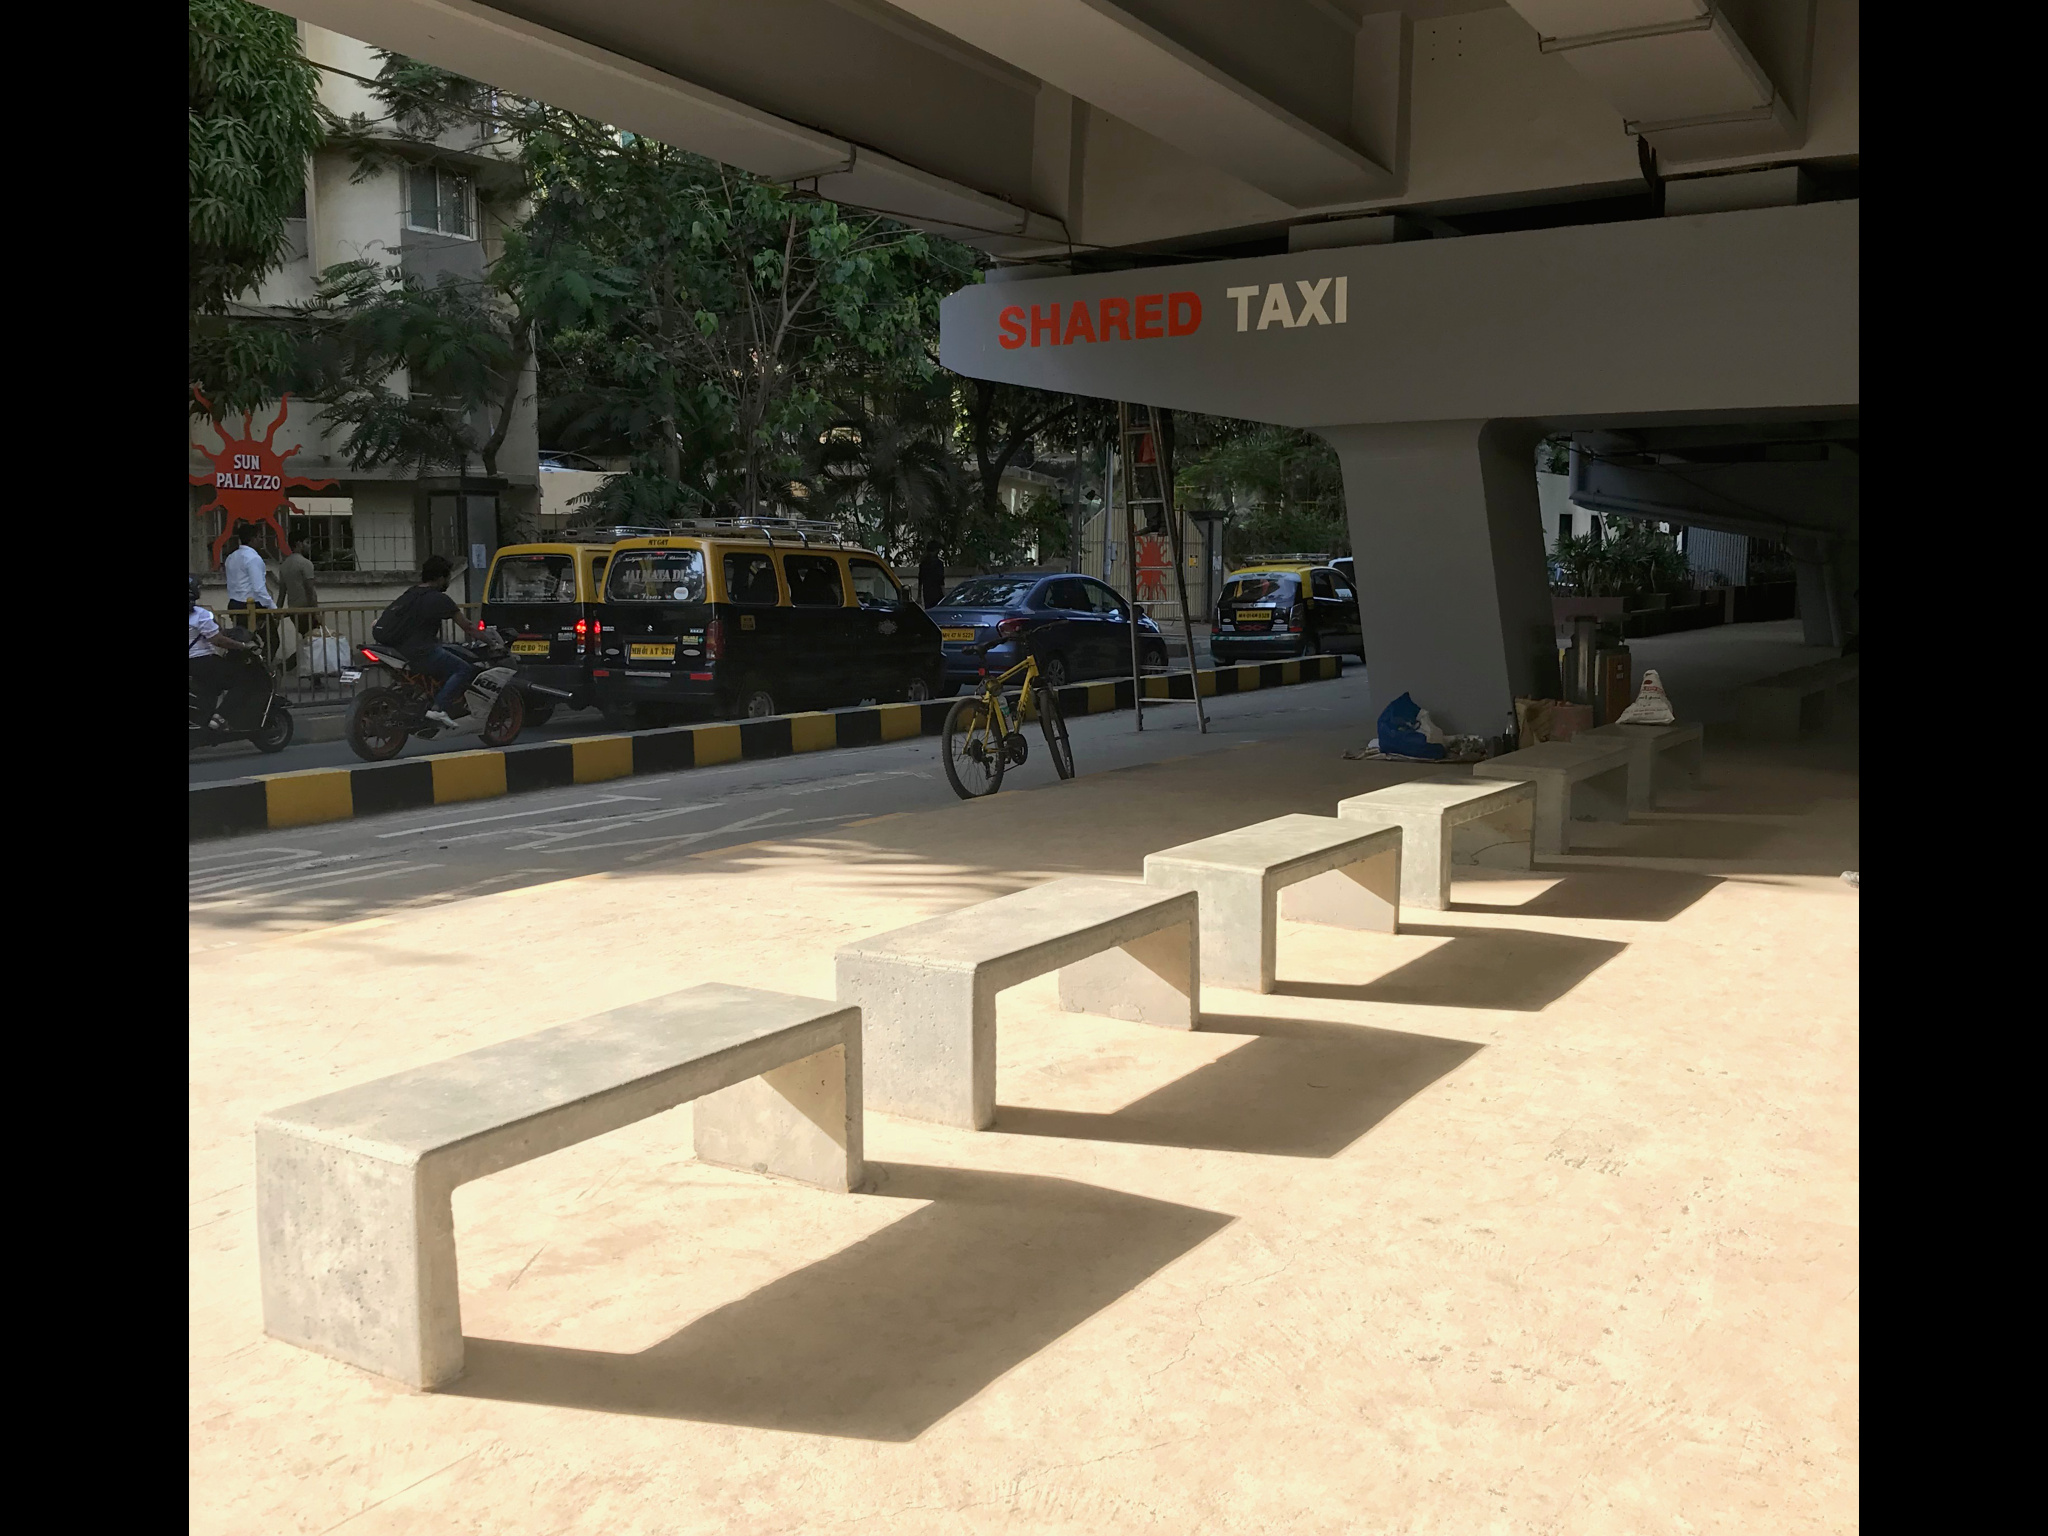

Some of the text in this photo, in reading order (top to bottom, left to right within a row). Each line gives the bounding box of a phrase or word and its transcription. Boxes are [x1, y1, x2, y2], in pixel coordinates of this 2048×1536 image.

[998, 275, 1348, 350] SHARED TAXI
[233, 454, 261, 471] SUN
[216, 472, 281, 491] PALAZZO
[622, 569, 641, 583] JAI
[641, 569, 671, 583] MATA
[473, 678, 502, 694] KTM
